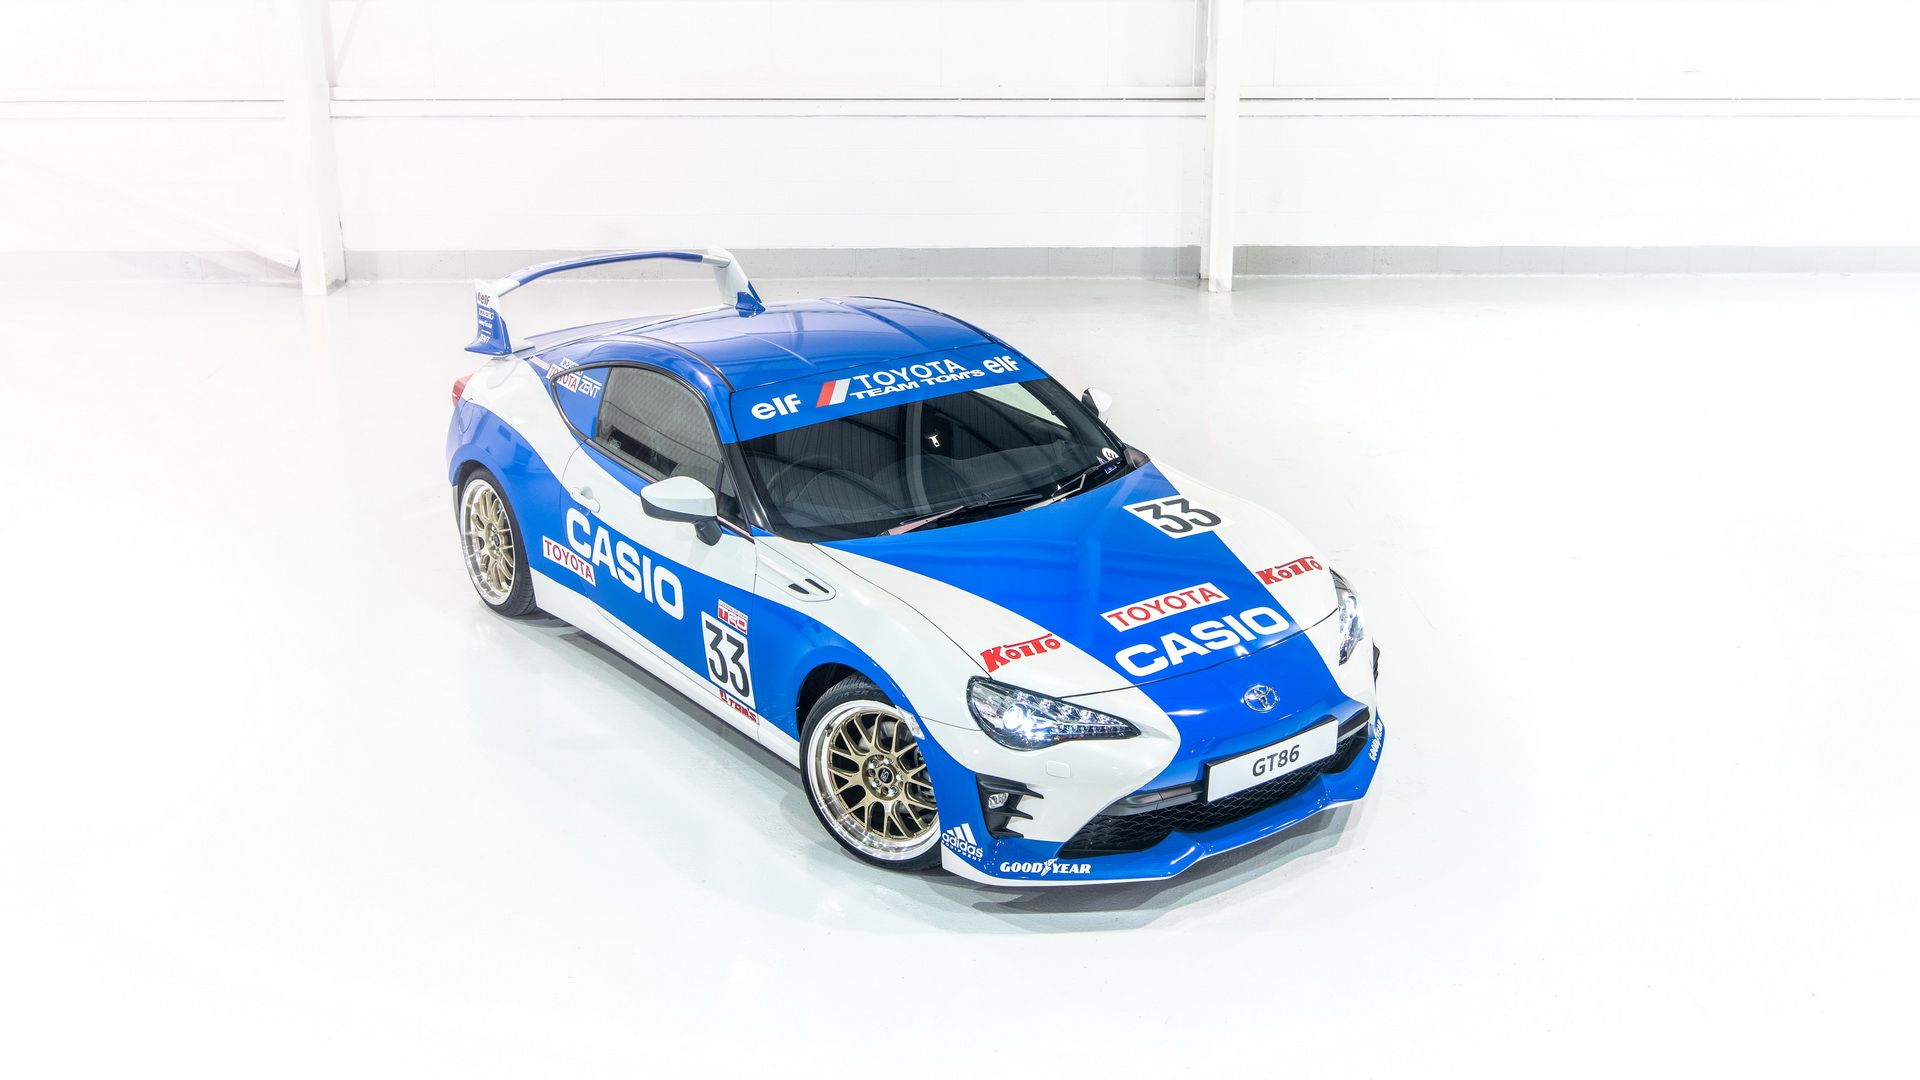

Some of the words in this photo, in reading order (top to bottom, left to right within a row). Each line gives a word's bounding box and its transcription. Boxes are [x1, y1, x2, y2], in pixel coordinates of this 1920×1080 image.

[549, 366, 578, 391] TOOTA
[853, 359, 967, 389] TOYOTA
[983, 355, 1021, 374] elf
[578, 379, 601, 399] ZENT
[849, 380, 921, 399] TEAM
[751, 393, 802, 420] elf
[1136, 498, 1222, 534] 33
[544, 539, 594, 583] TOYOTA
[566, 507, 684, 620] CASIO
[1107, 587, 1223, 627] TOYOTA
[1115, 606, 1290, 677] CASIO
[705, 619, 750, 698] 33
[1252, 744, 1300, 777] GT86
[941, 832, 984, 858] adidas
[1000, 860, 1092, 875] GOODYEAR
